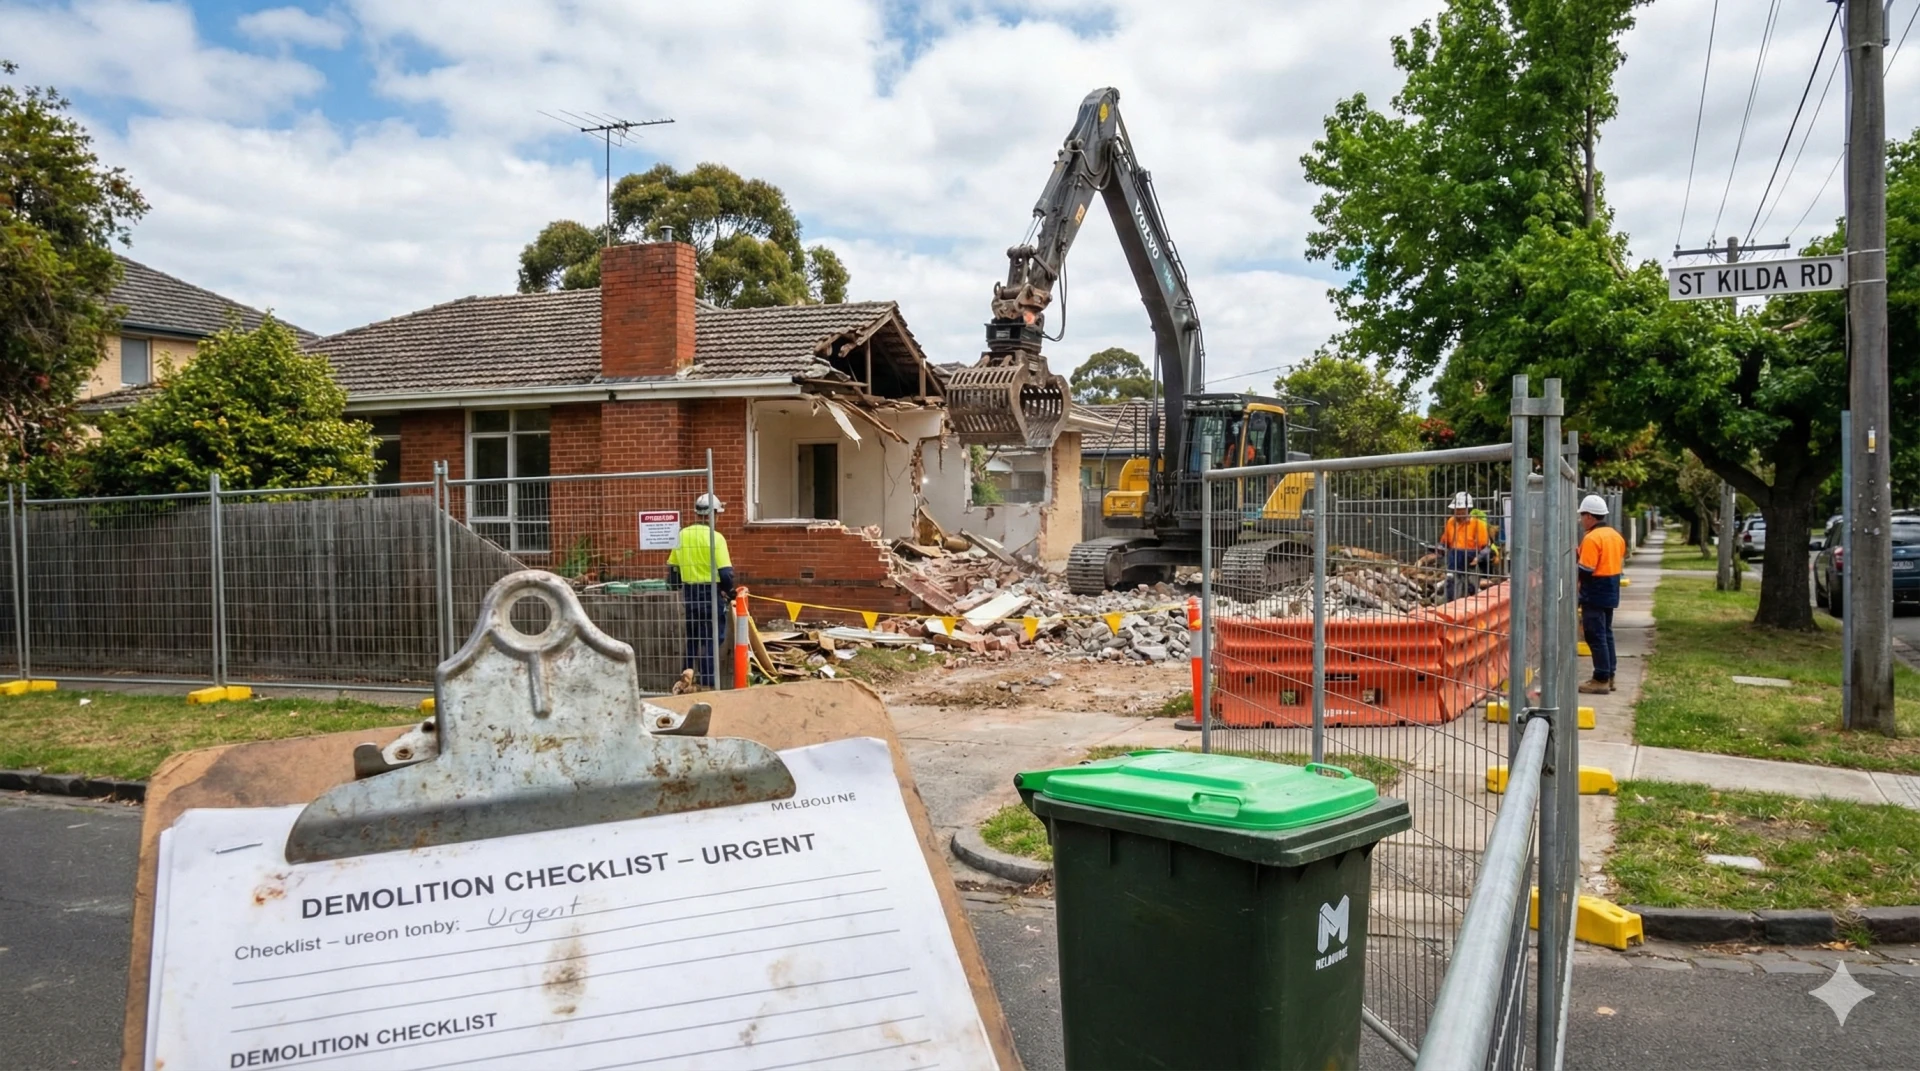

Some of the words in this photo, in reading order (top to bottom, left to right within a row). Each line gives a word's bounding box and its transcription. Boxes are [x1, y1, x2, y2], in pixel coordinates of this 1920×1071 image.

[1135, 199, 1159, 259] VOLVO
[1678, 271, 1706, 296] ST
[1717, 265, 1789, 293] KILDA
[1800, 262, 1833, 288] RD
[302, 875, 495, 919] DEMOLITION
[505, 853, 669, 892] CHECKLIST
[702, 834, 815, 865] URGENT
[487, 895, 583, 934] Urgent
[234, 936, 321, 961] Checklist
[345, 931, 399, 947] ureon
[405, 918, 460, 943] tonby:
[230, 1033, 369, 1068] DEMOLITION
[377, 1013, 497, 1045] CHECKLIST
